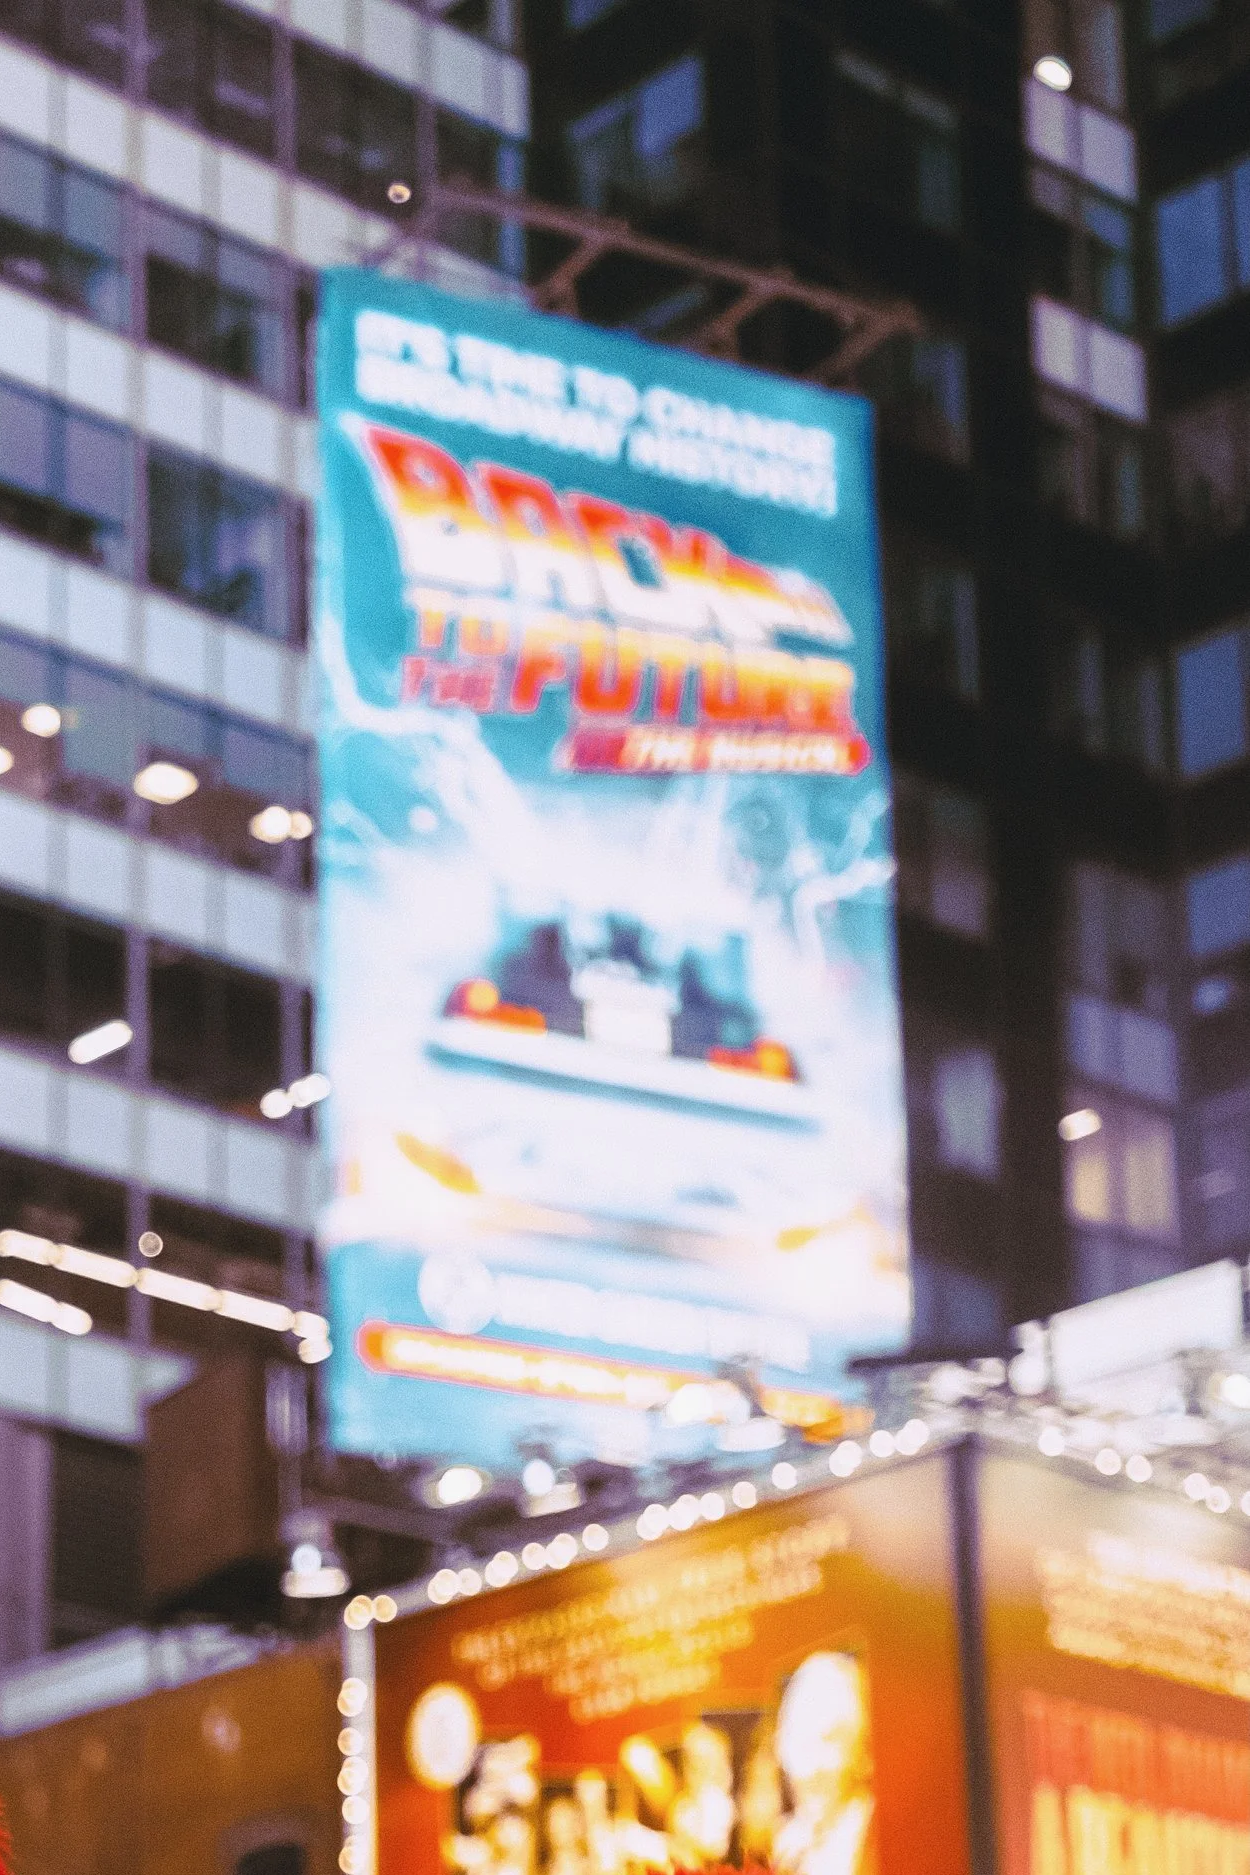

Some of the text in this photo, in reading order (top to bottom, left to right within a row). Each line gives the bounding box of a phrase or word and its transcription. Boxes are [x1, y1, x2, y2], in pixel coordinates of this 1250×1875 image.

[342, 412, 852, 648] BACK
[410, 590, 510, 657] TO
[510, 608, 856, 728] FUTURE
